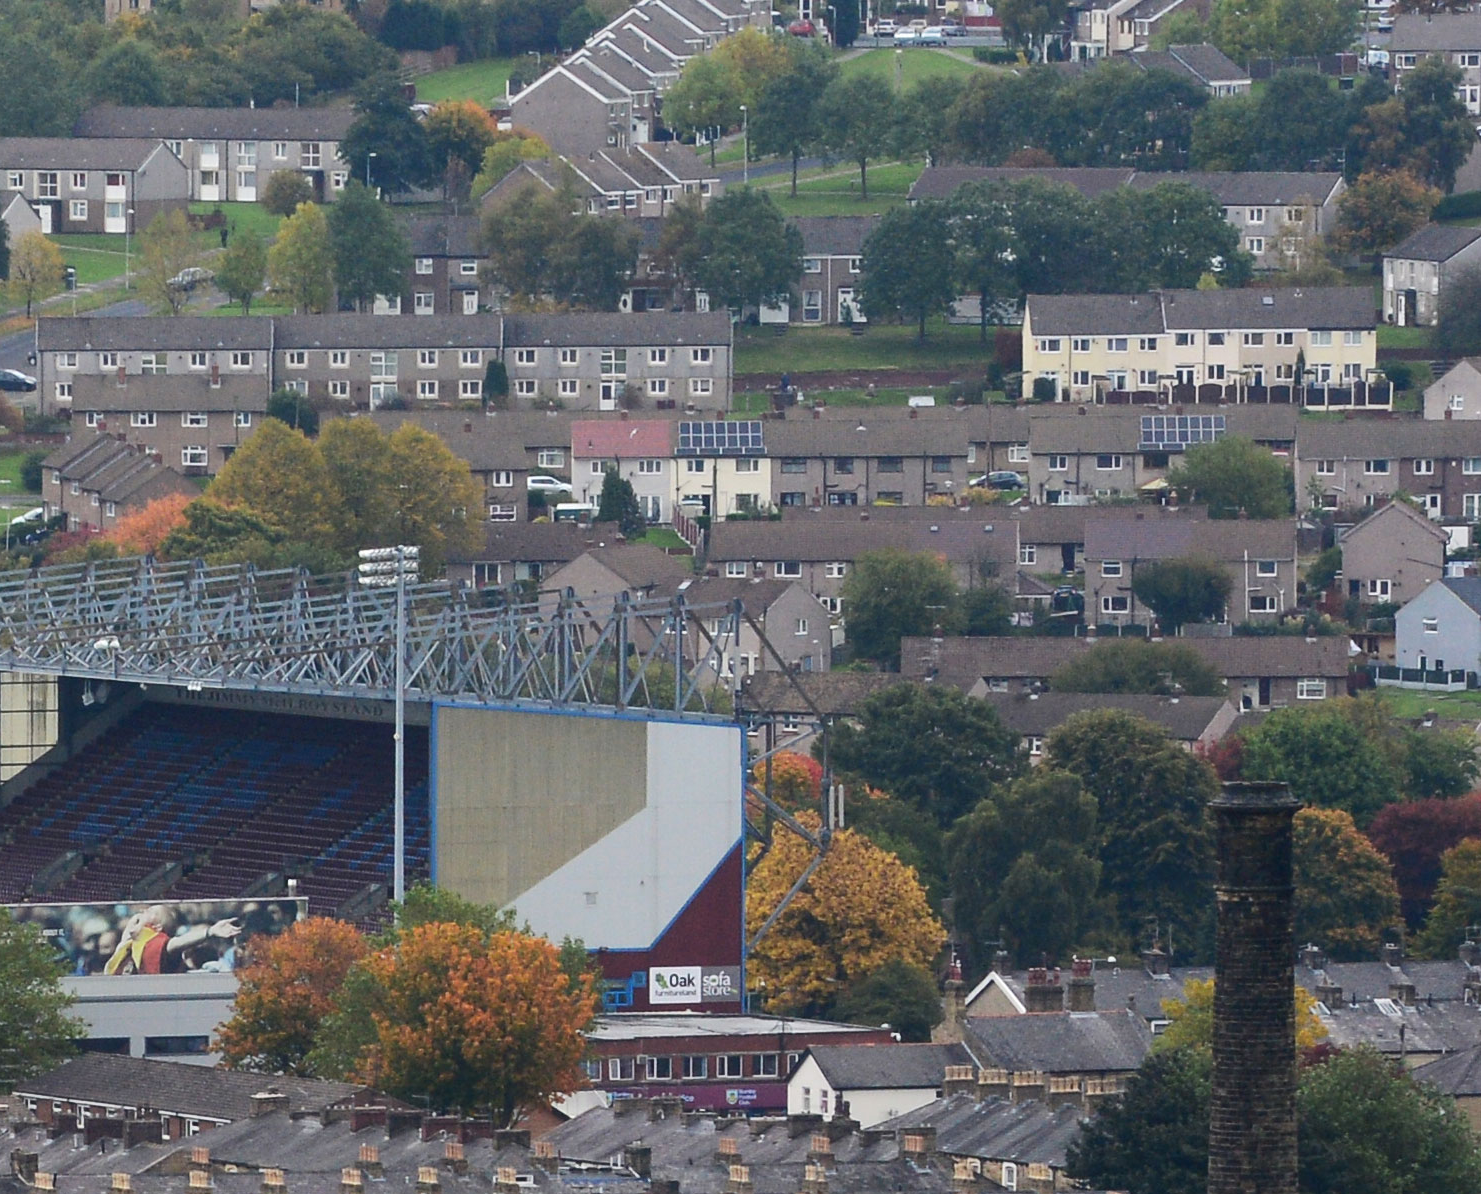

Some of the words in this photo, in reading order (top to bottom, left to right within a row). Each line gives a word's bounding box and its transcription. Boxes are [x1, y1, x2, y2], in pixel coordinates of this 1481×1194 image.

[333, 701, 384, 717] STAND
[669, 973, 695, 988] Oak
[702, 971, 731, 986] sofa
[702, 986, 731, 996] store
